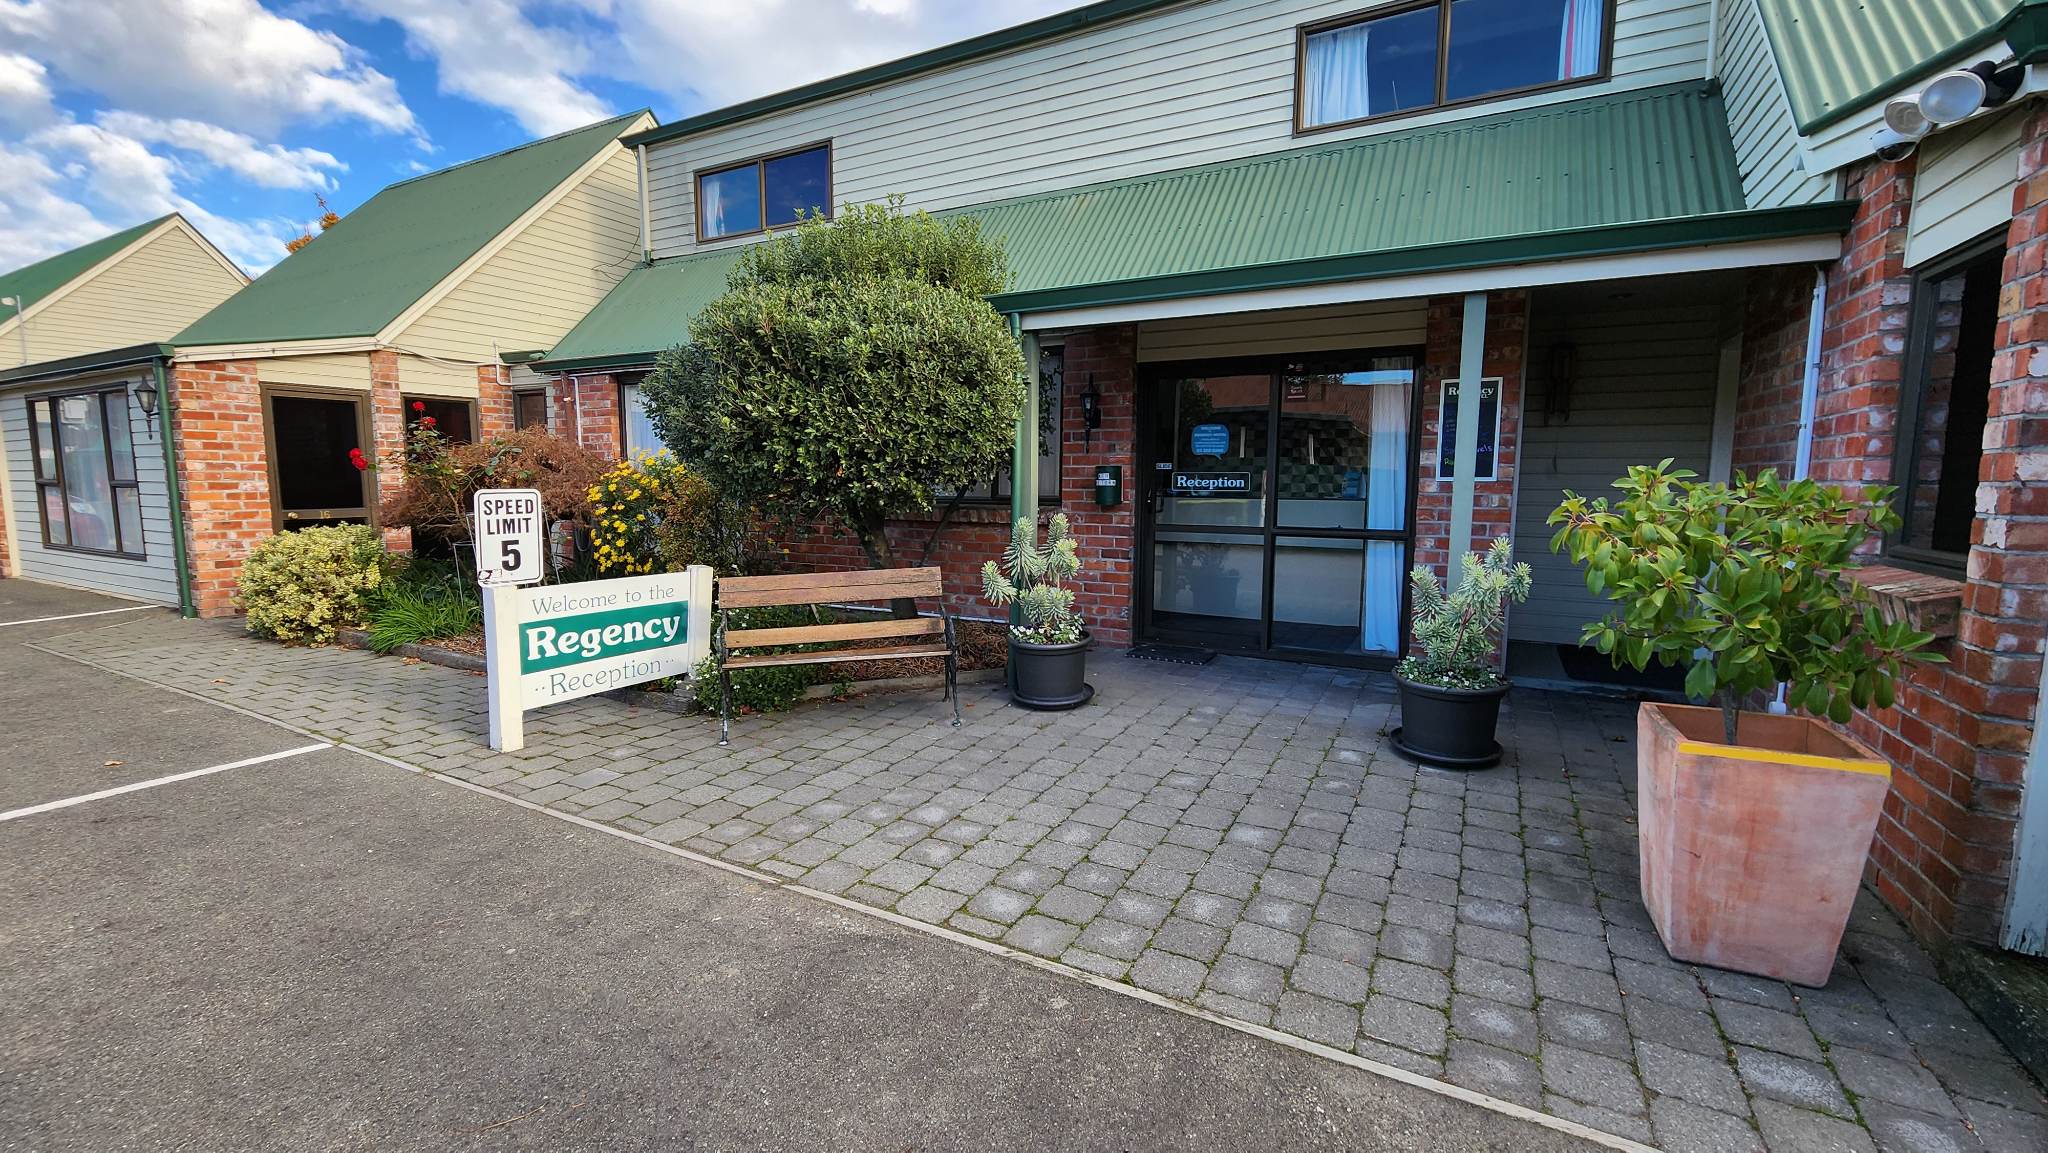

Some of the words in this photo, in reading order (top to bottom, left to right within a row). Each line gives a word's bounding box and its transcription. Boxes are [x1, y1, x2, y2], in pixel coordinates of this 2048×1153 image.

[1176, 475, 1245, 489] Reception
[483, 499, 534, 516] SPEED
[486, 517, 532, 535] LIMIT
[501, 539, 521, 571] 5
[532, 593, 617, 615] Welcome
[626, 589, 642, 603] to
[649, 584, 674, 600] the
[525, 615, 681, 661] Regency
[549, 659, 662, 696] Reception
